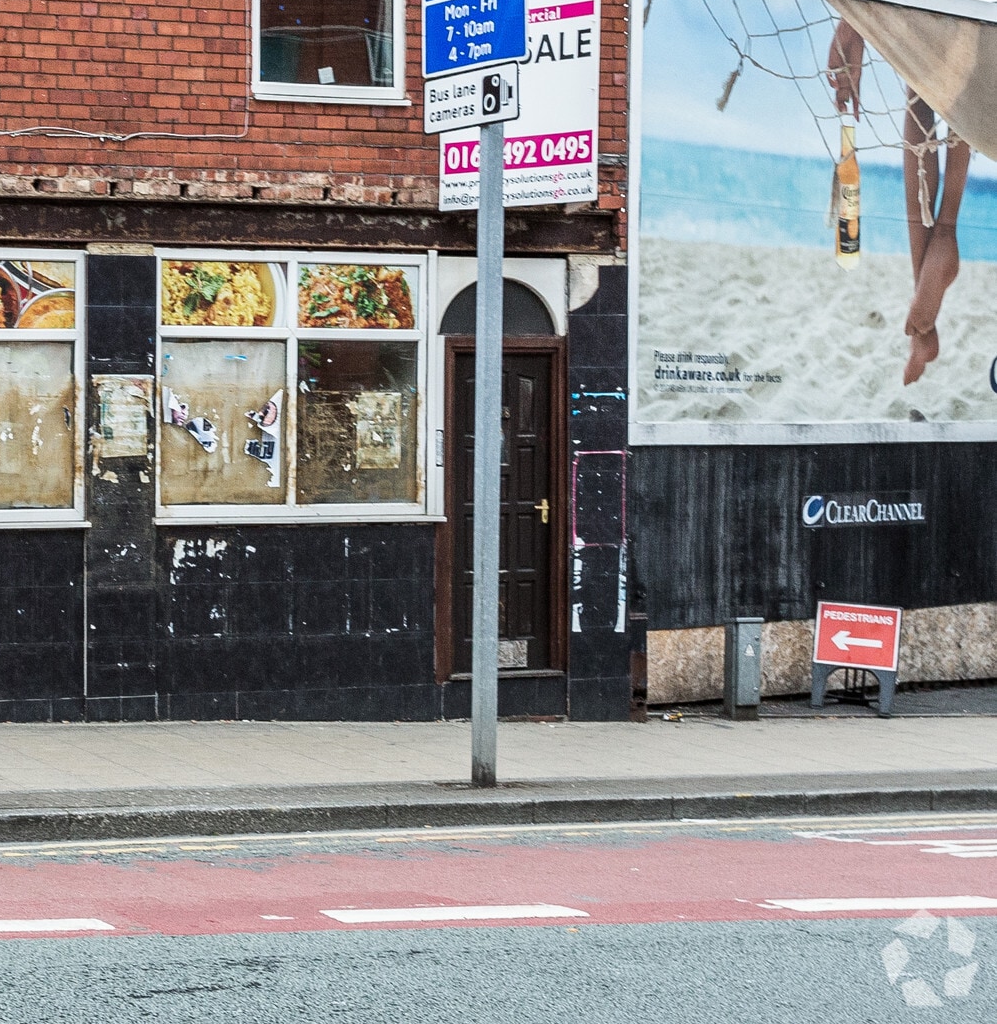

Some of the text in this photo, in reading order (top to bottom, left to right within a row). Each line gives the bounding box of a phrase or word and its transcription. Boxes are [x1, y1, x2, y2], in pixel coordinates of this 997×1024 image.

[444, 4, 469, 21] Mon
[445, 25, 455, 42] 7
[464, 20, 495, 38] 10am
[448, 46, 458, 62] 4
[467, 42, 492, 61] 7pm
[430, 84, 476, 103] Bus lane
[430, 104, 475, 123] cameras
[447, 134, 591, 170] 016 492 0495
[654, 350, 675, 363] Please
[677, 351, 693, 363] drink
[654, 364, 782, 383] drinkaware.co.uk for the facts
[824, 610, 894, 626] PEDESTRIANS
